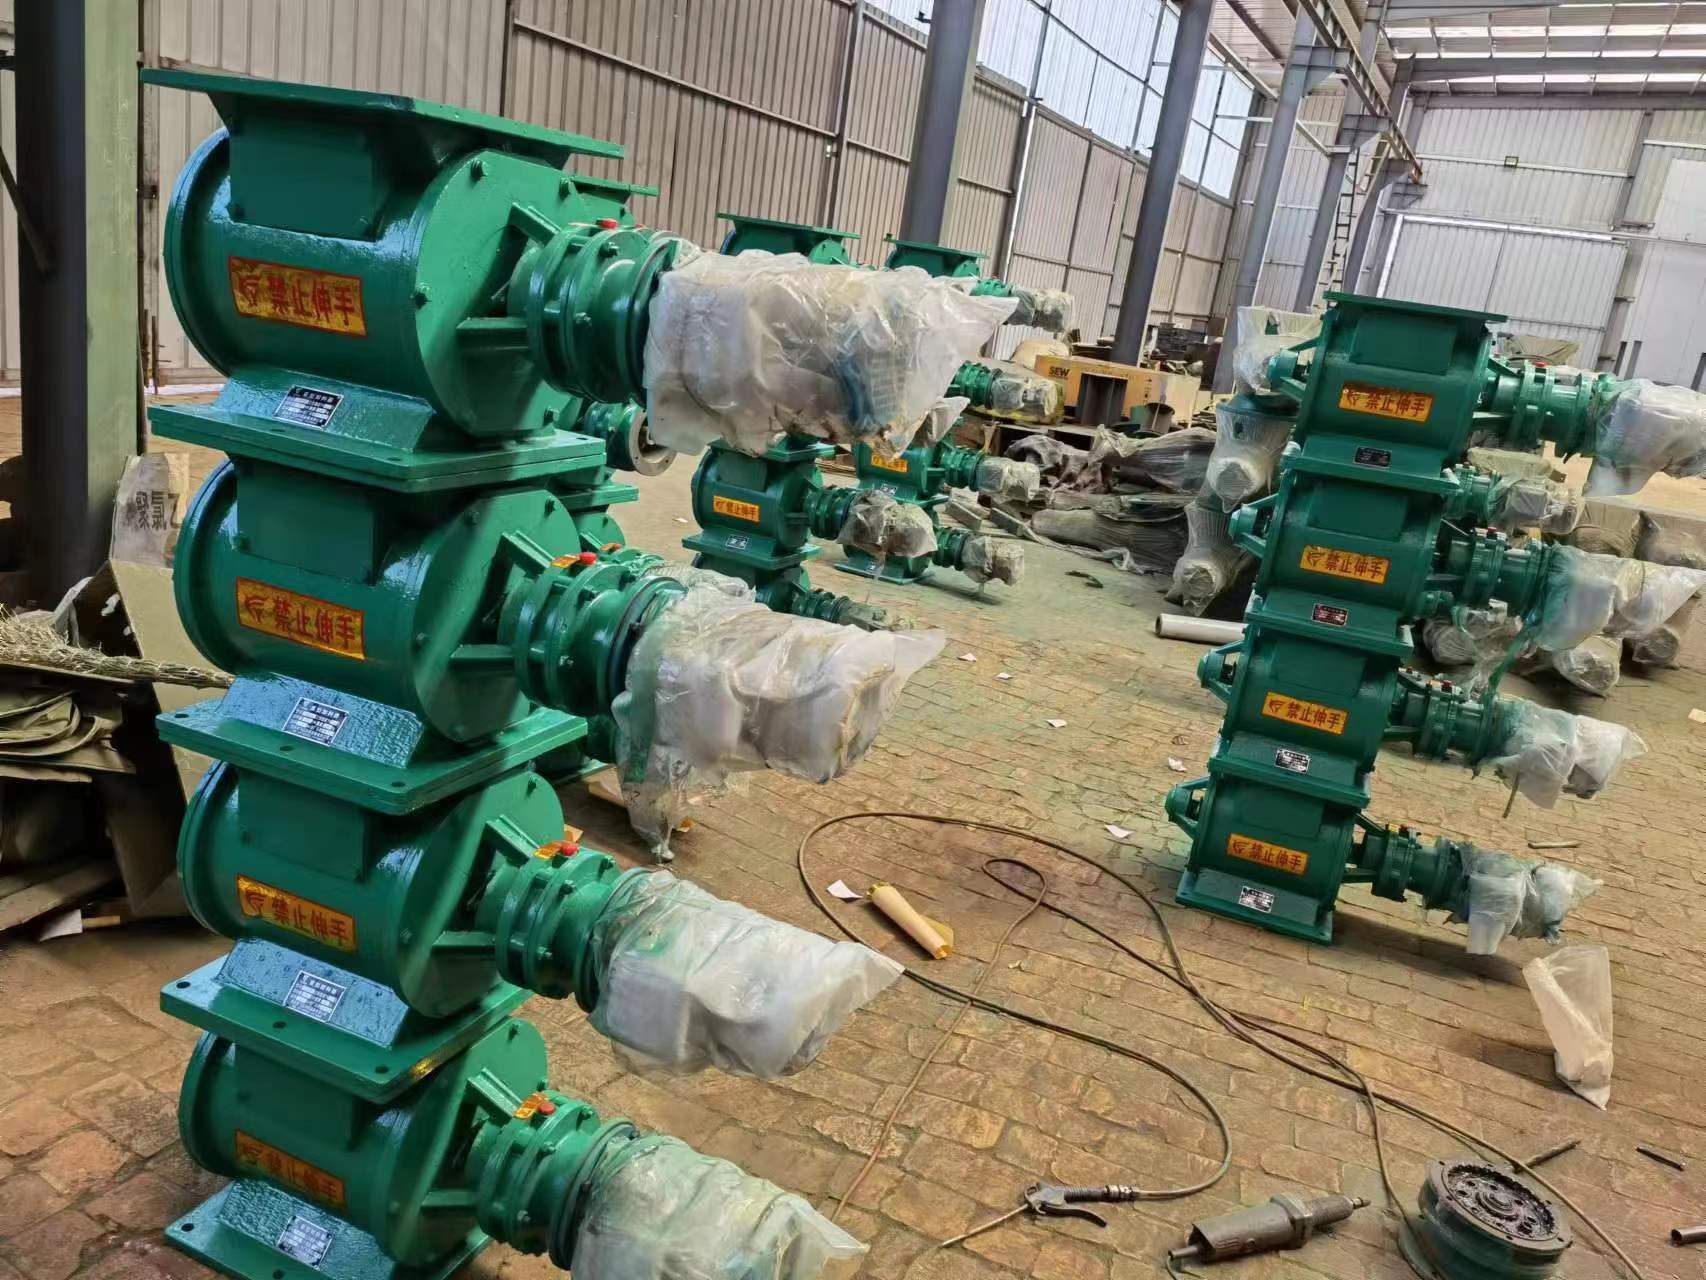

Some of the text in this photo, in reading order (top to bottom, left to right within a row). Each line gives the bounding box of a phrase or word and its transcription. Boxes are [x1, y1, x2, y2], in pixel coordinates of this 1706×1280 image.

[266, 272, 355, 326] 禁止伸手
[1048, 366, 1070, 378] SEW
[1365, 390, 1425, 417] 禁止伸手
[1325, 550, 1383, 579] 禁止伸手
[272, 595, 355, 650] 禁止伸手
[1286, 701, 1341, 729] 禁止伸手
[1248, 842, 1301, 870] 禁止伸手
[271, 895, 348, 946] 禁止伸手
